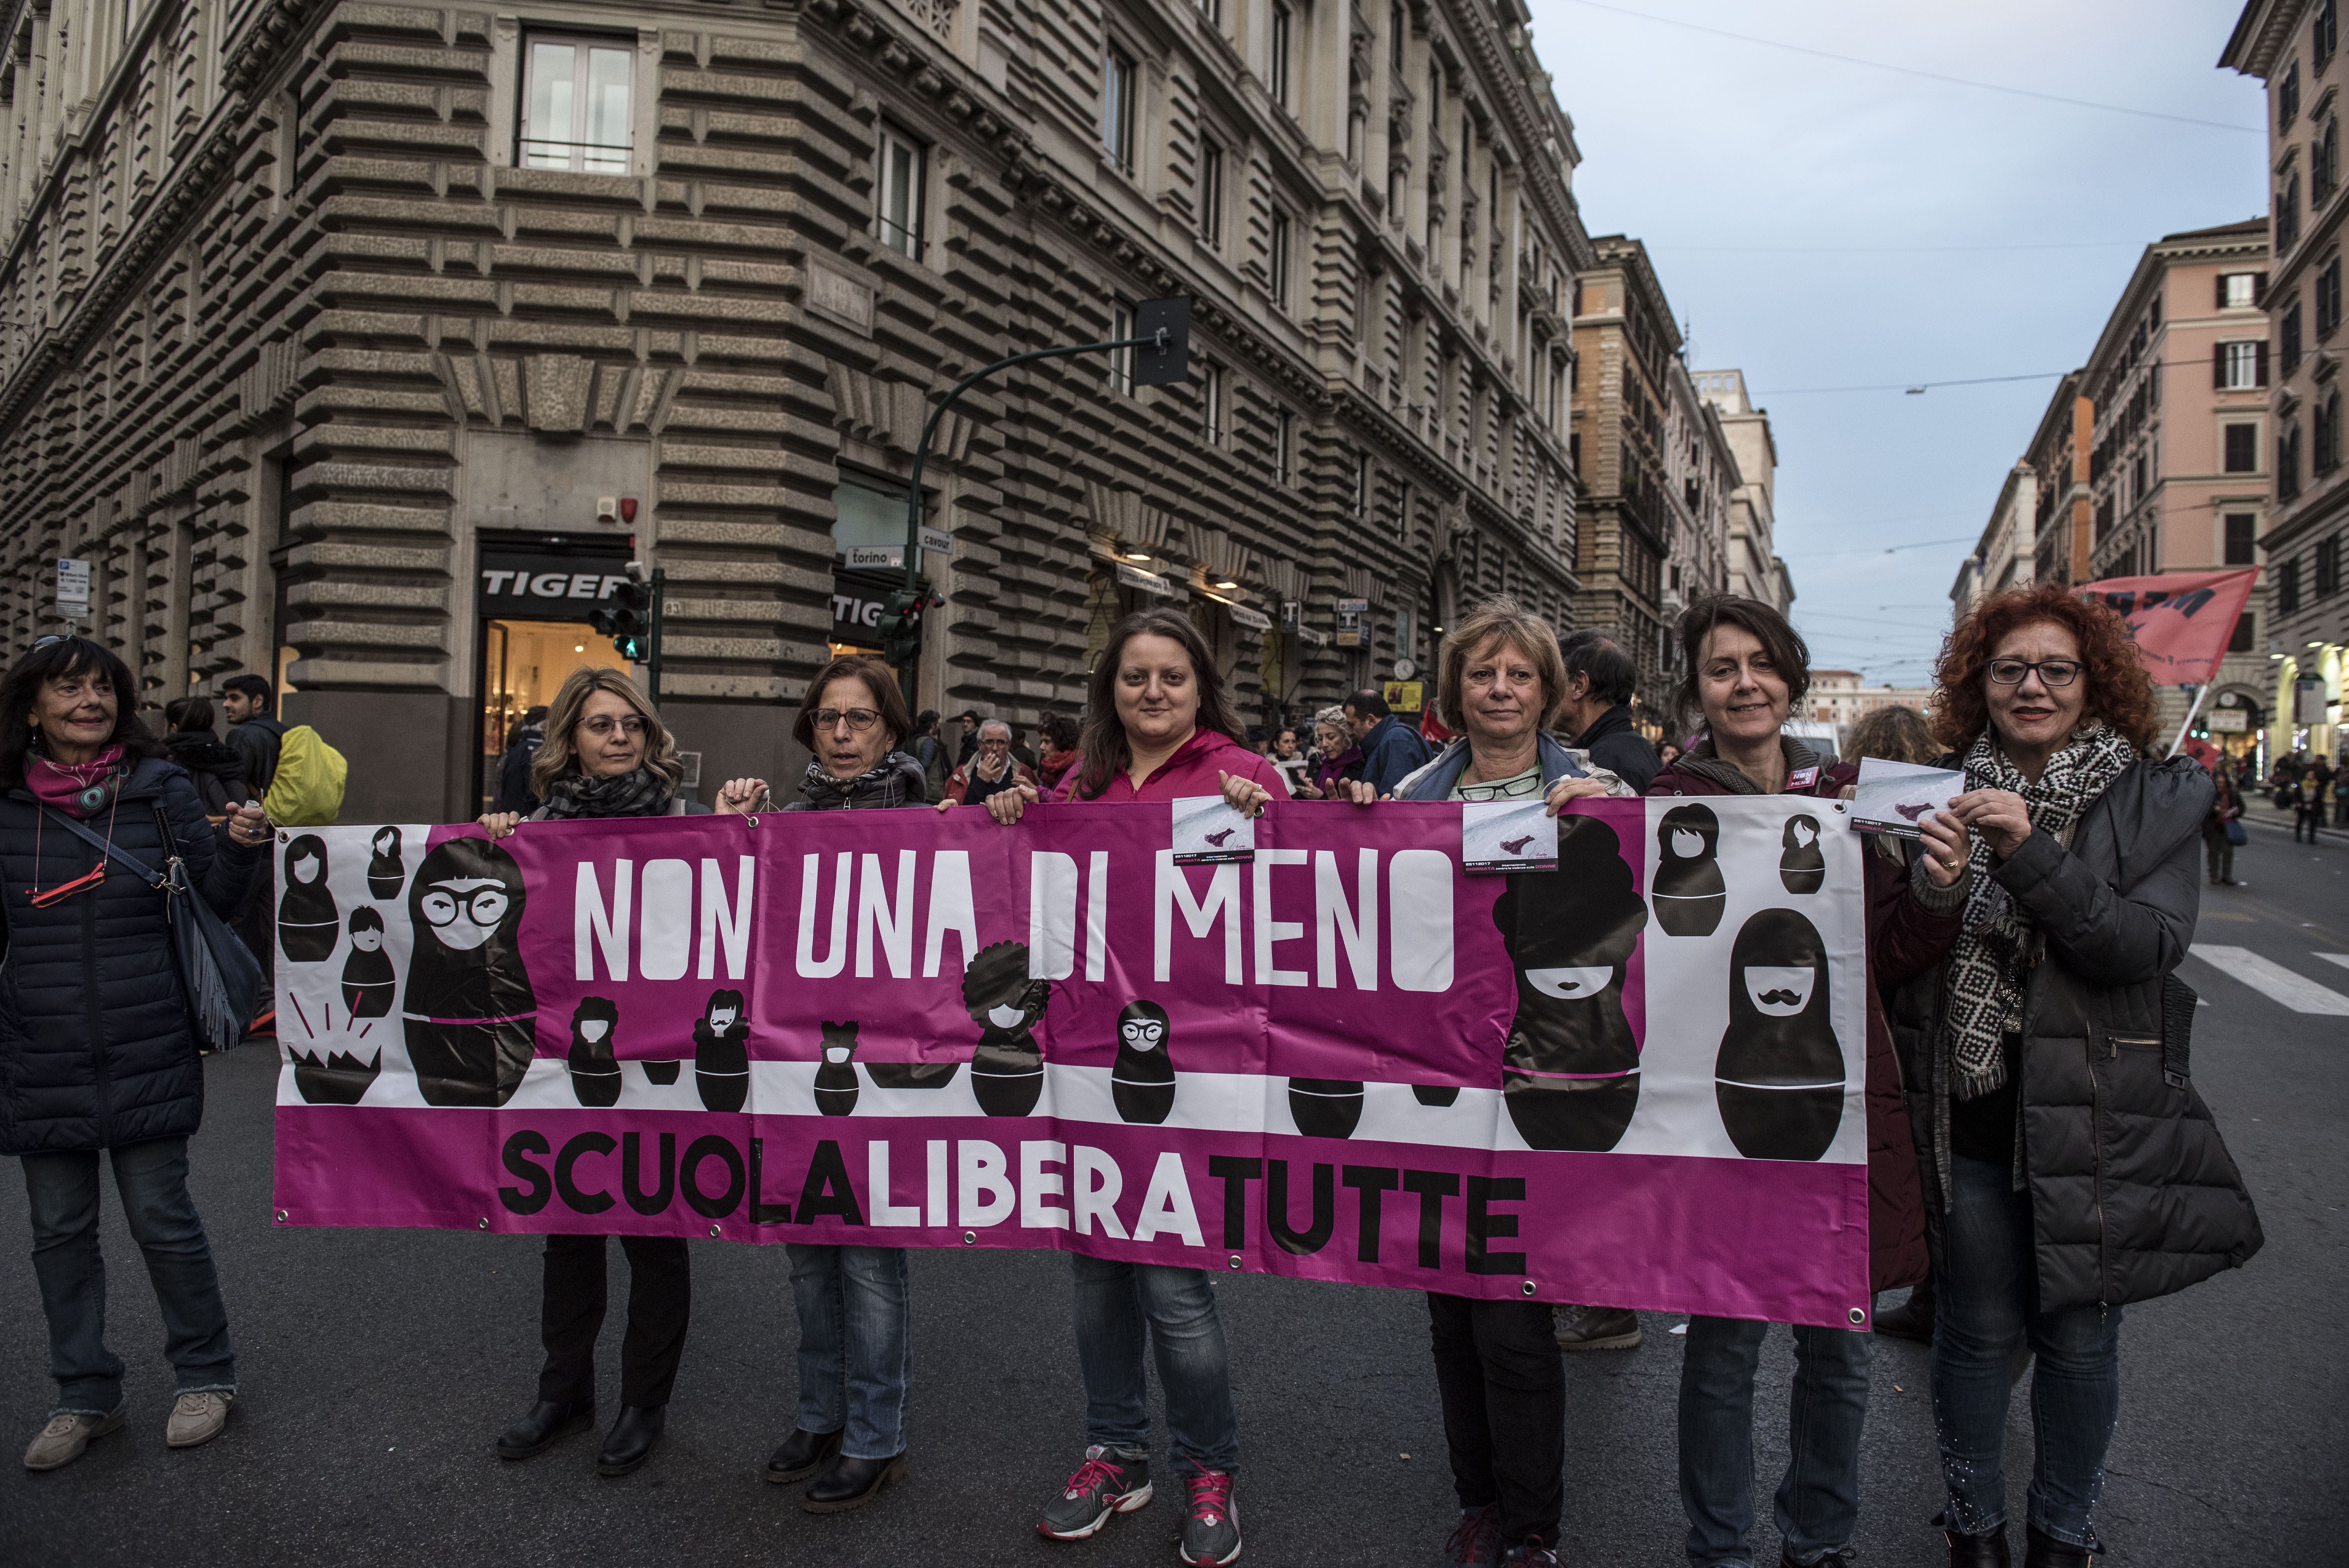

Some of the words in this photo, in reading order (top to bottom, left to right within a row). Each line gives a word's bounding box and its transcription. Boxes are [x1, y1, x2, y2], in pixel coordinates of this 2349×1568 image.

[925, 535, 950, 550] cavour
[853, 551, 887, 563] torino
[1793, 771, 1812, 779] NON
[1853, 824, 1886, 832] GIORNATA
[574, 855, 755, 981] NON
[795, 850, 978, 979] UNA
[1028, 851, 1108, 981] DI
[1154, 848, 1454, 992] MENO
